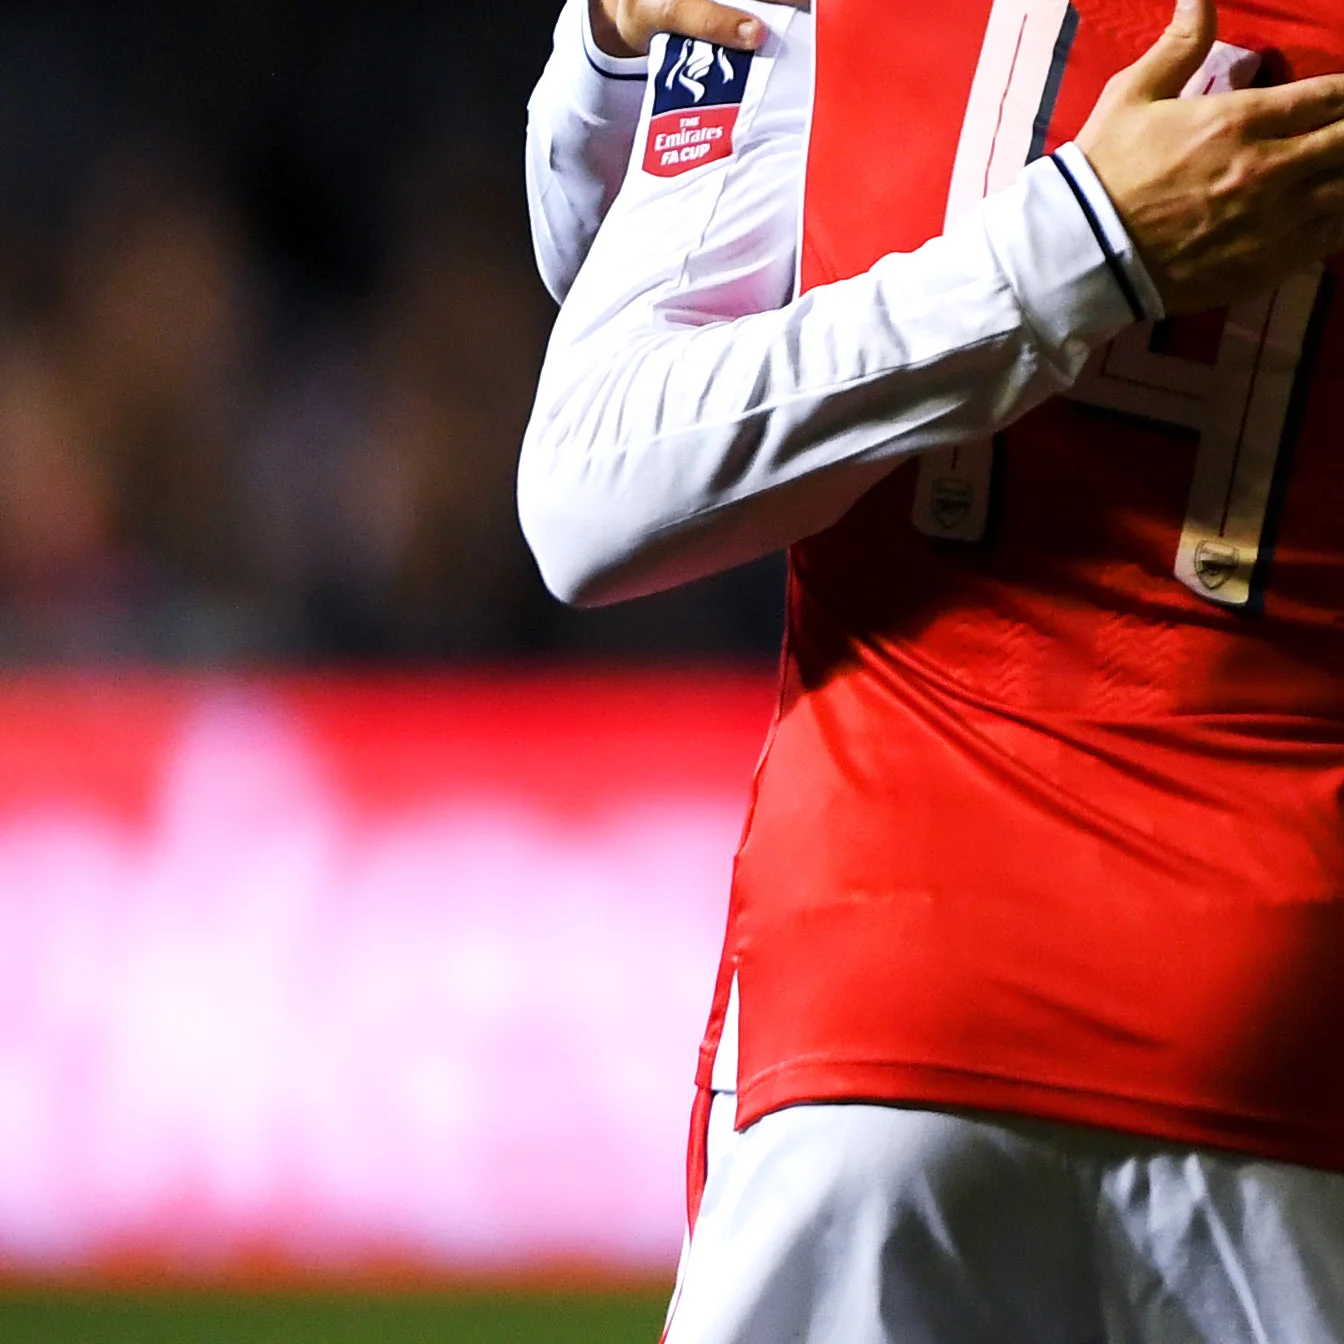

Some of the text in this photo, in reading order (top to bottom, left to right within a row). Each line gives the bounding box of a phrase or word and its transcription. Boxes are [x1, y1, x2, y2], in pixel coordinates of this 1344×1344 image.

[654, 125, 724, 152] Emirates
[660, 142, 711, 166] FA CUP
